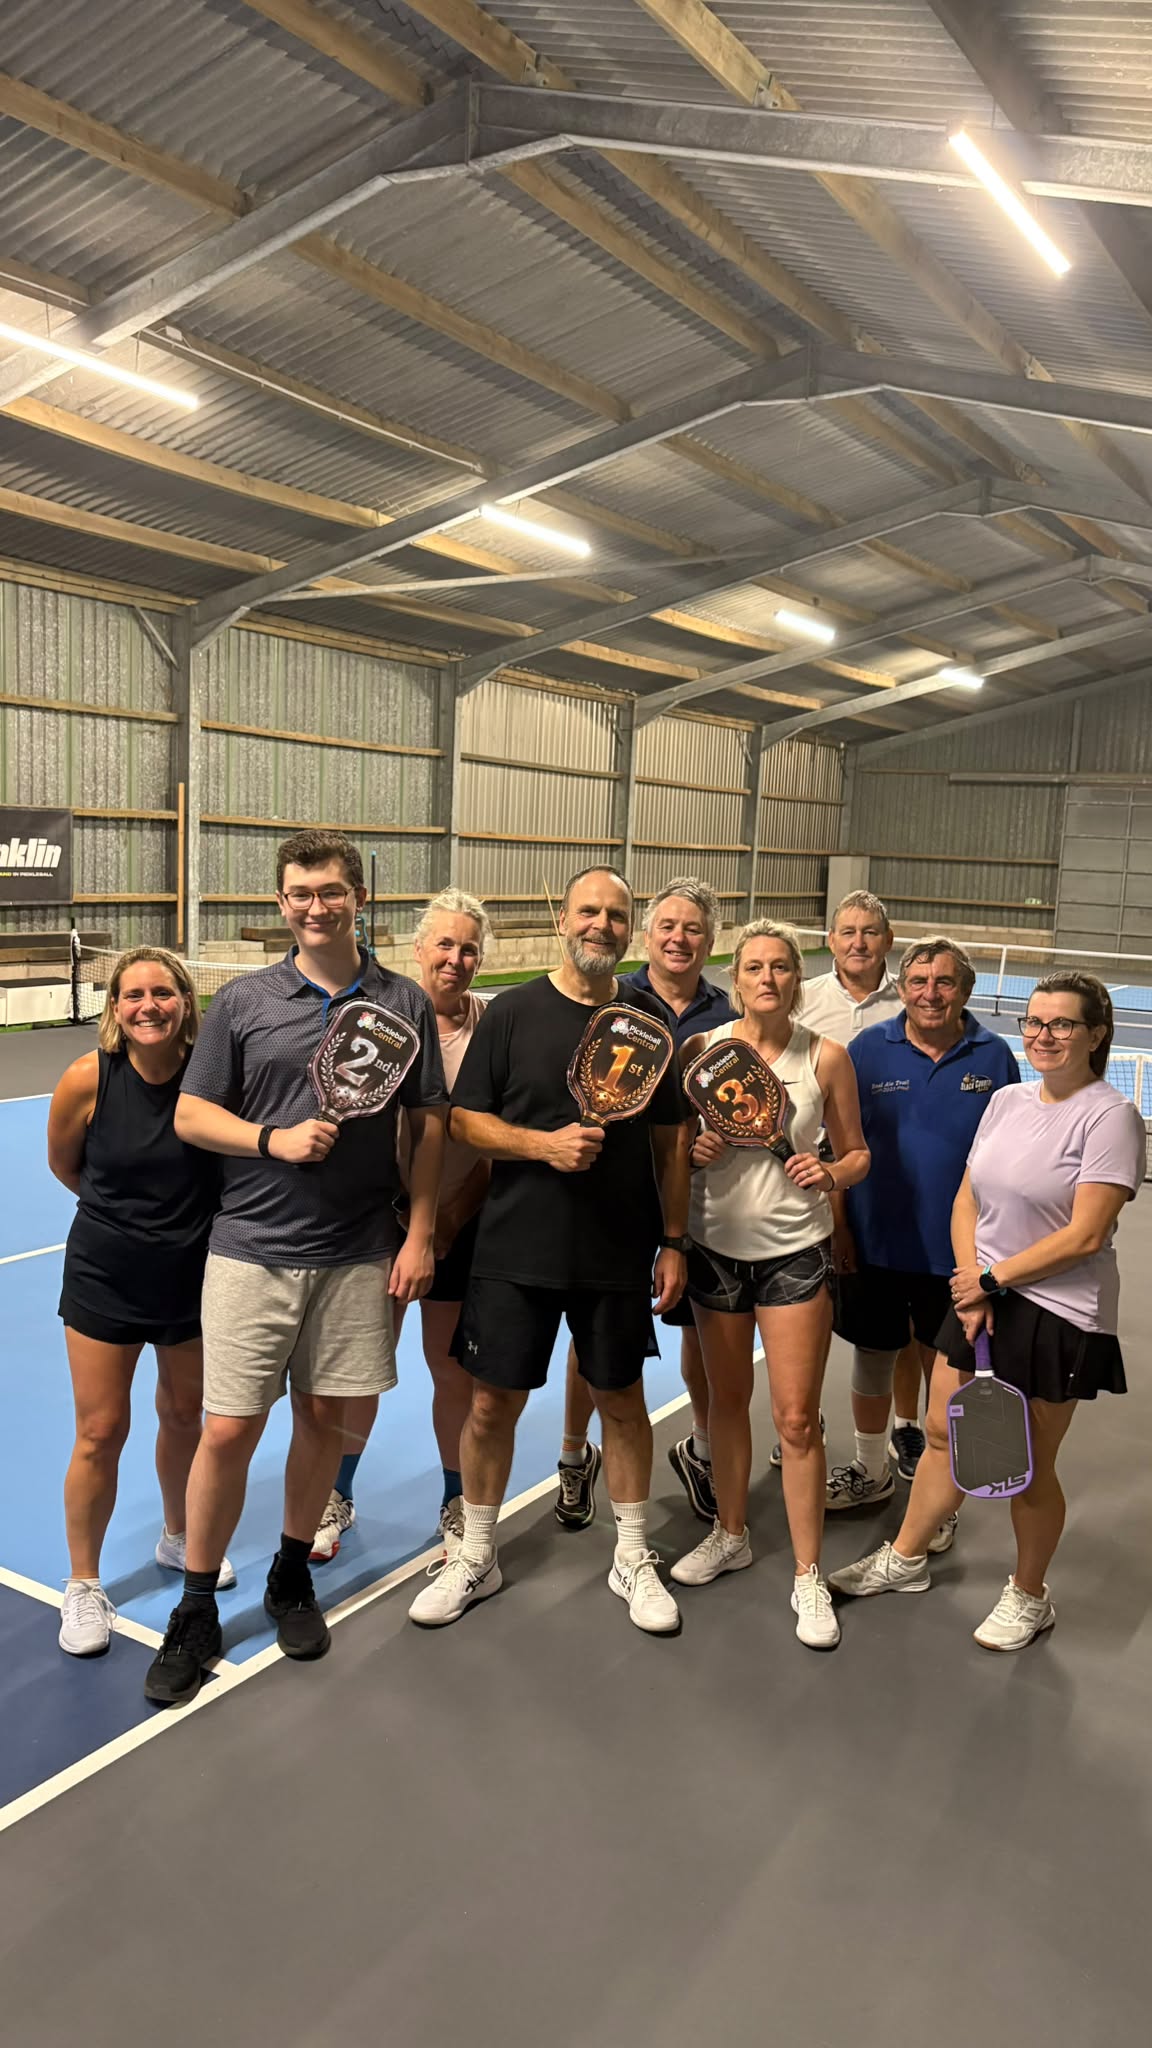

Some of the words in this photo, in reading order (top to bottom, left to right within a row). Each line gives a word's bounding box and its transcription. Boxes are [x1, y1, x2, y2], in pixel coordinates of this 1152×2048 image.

[372, 1028, 404, 1049] Central
[375, 1021, 408, 1043] Pickleball
[626, 1032, 657, 1052] Central
[629, 1025, 661, 1046] Pickleball
[709, 1049, 737, 1073] Pickleball
[714, 1056, 740, 1078] Central
